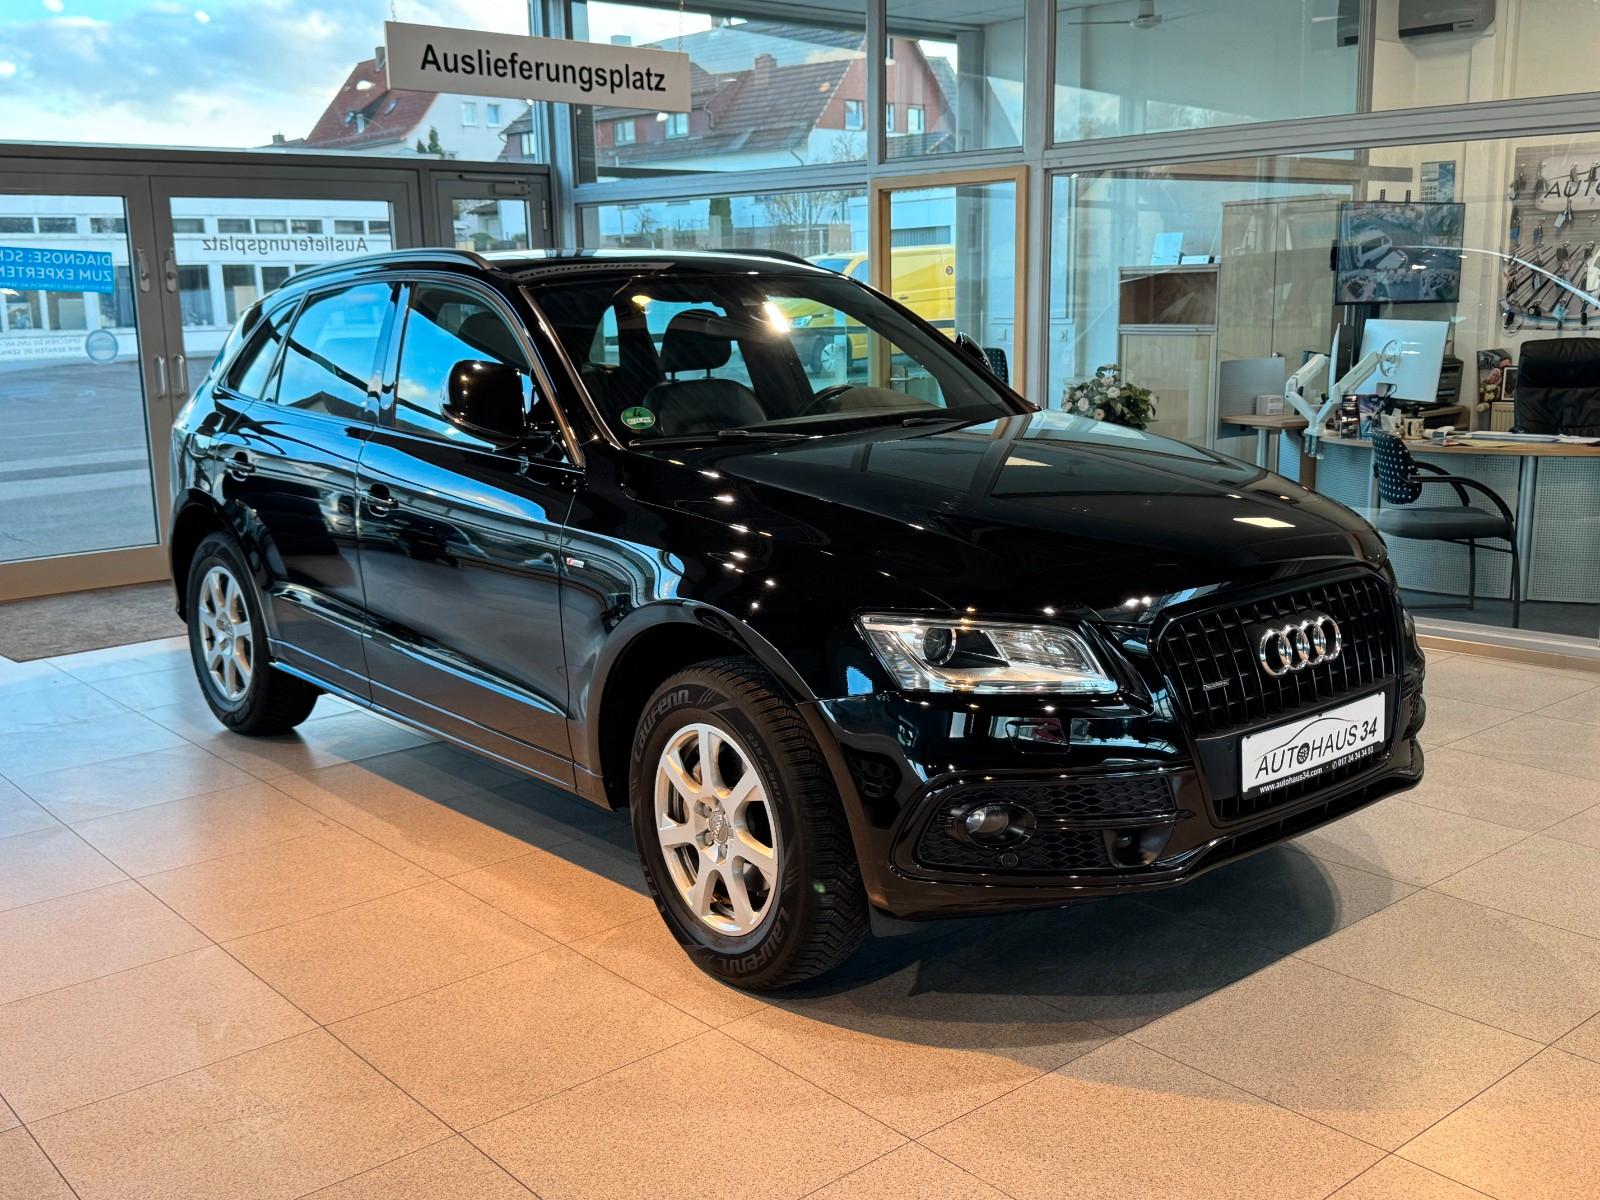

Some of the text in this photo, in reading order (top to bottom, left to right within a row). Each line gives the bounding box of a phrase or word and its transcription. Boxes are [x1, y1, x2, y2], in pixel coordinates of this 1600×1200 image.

[420, 43, 666, 94] Auslieferungsplatz
[1254, 717, 1377, 780] AUTOHAUS 34
[1259, 766, 1323, 794] www.autohaus34.com
